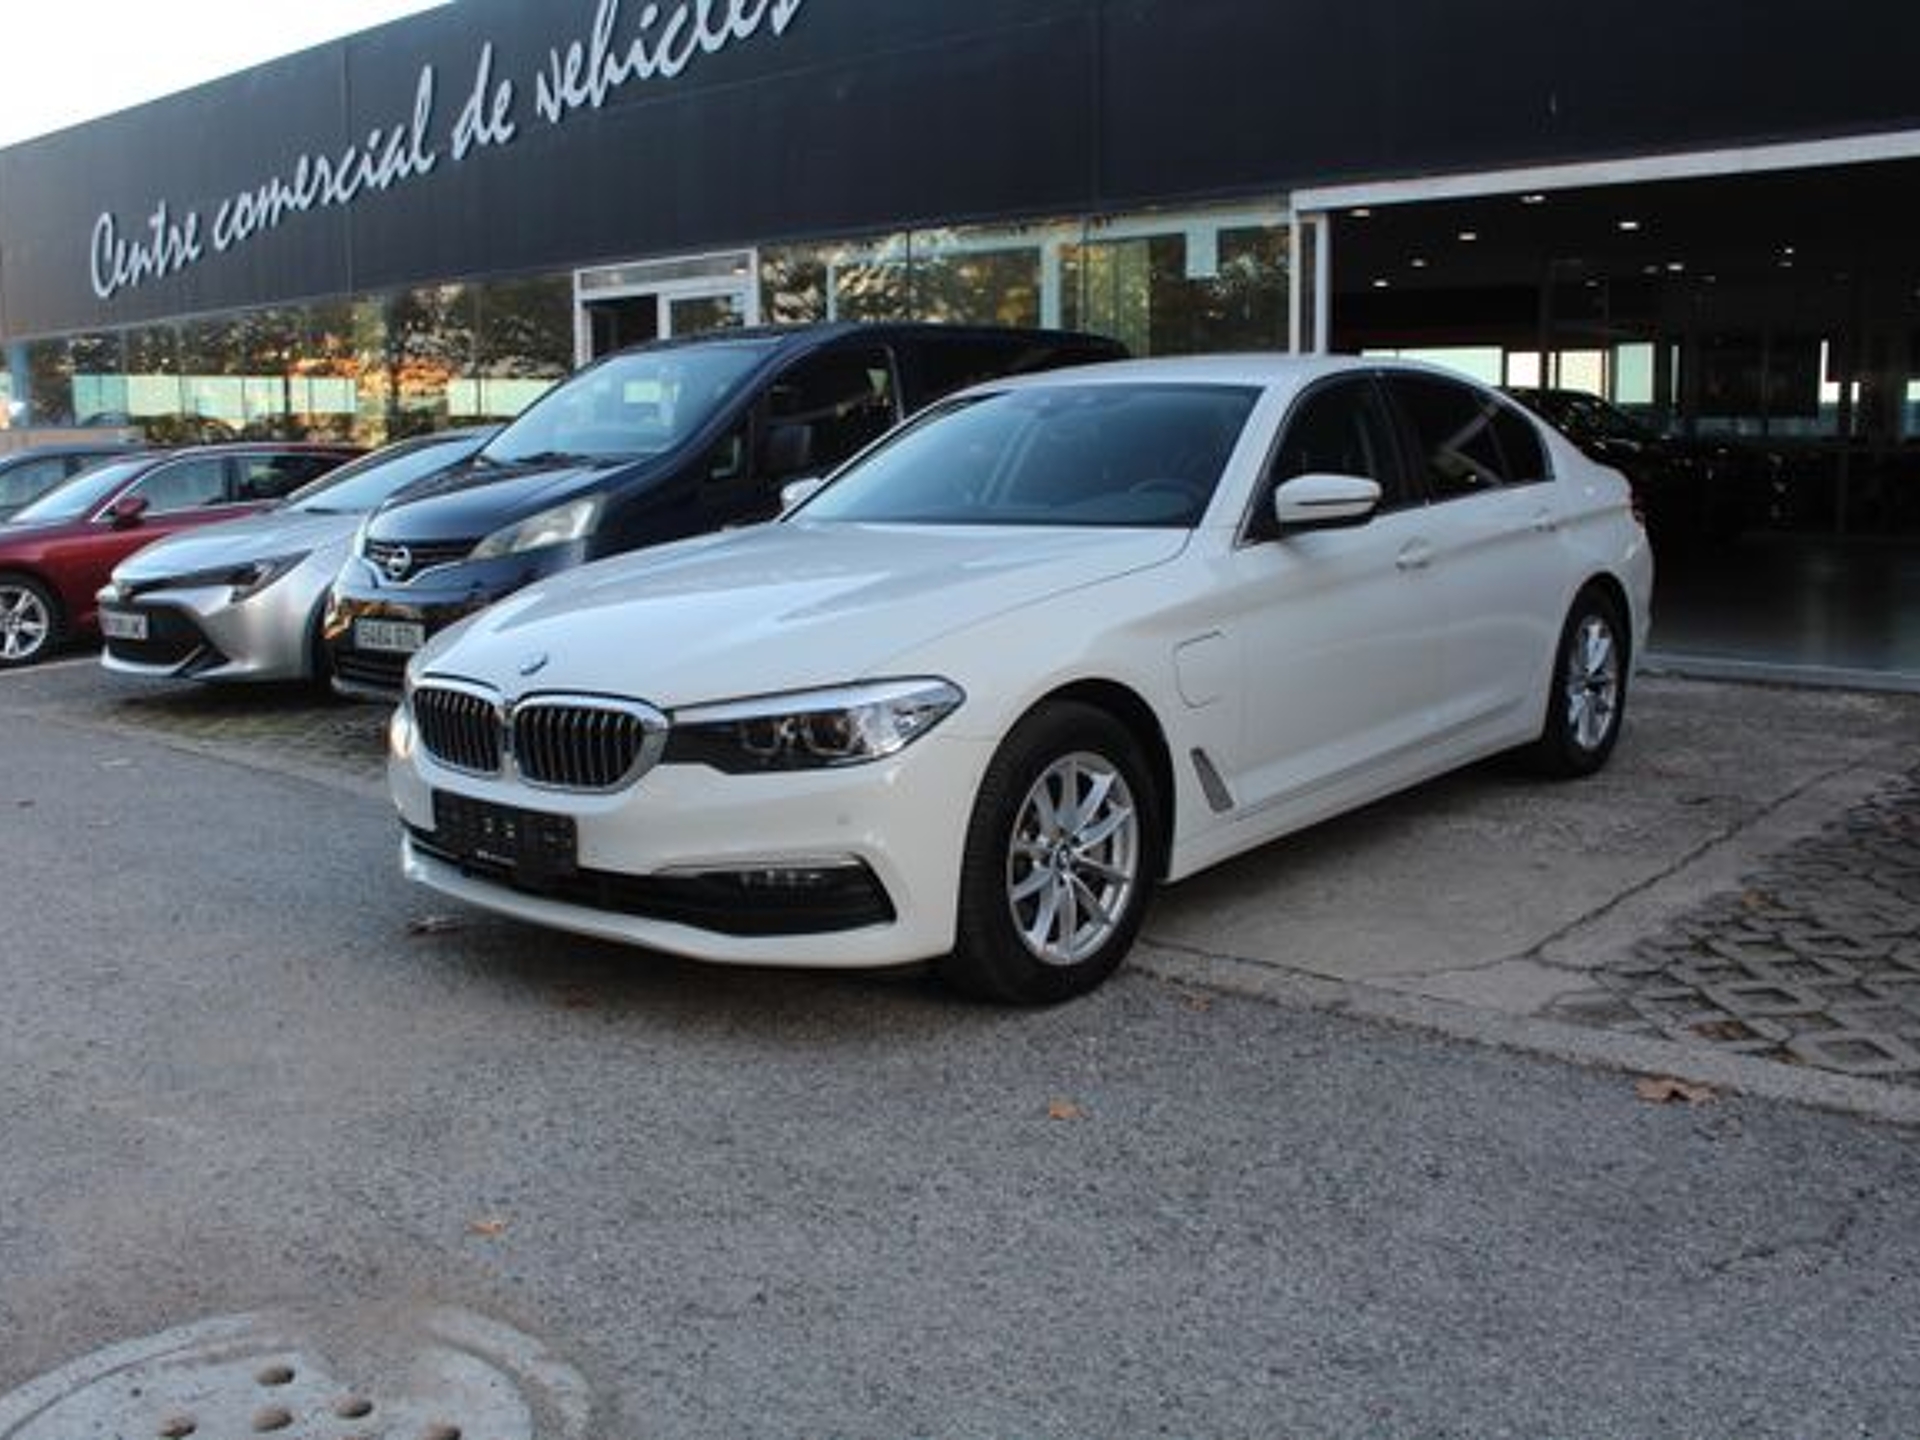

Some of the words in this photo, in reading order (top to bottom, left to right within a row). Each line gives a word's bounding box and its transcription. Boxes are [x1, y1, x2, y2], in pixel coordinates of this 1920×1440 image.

[91, 200, 201, 298] Centre
[213, 64, 436, 250] comercial
[451, 41, 515, 161] de
